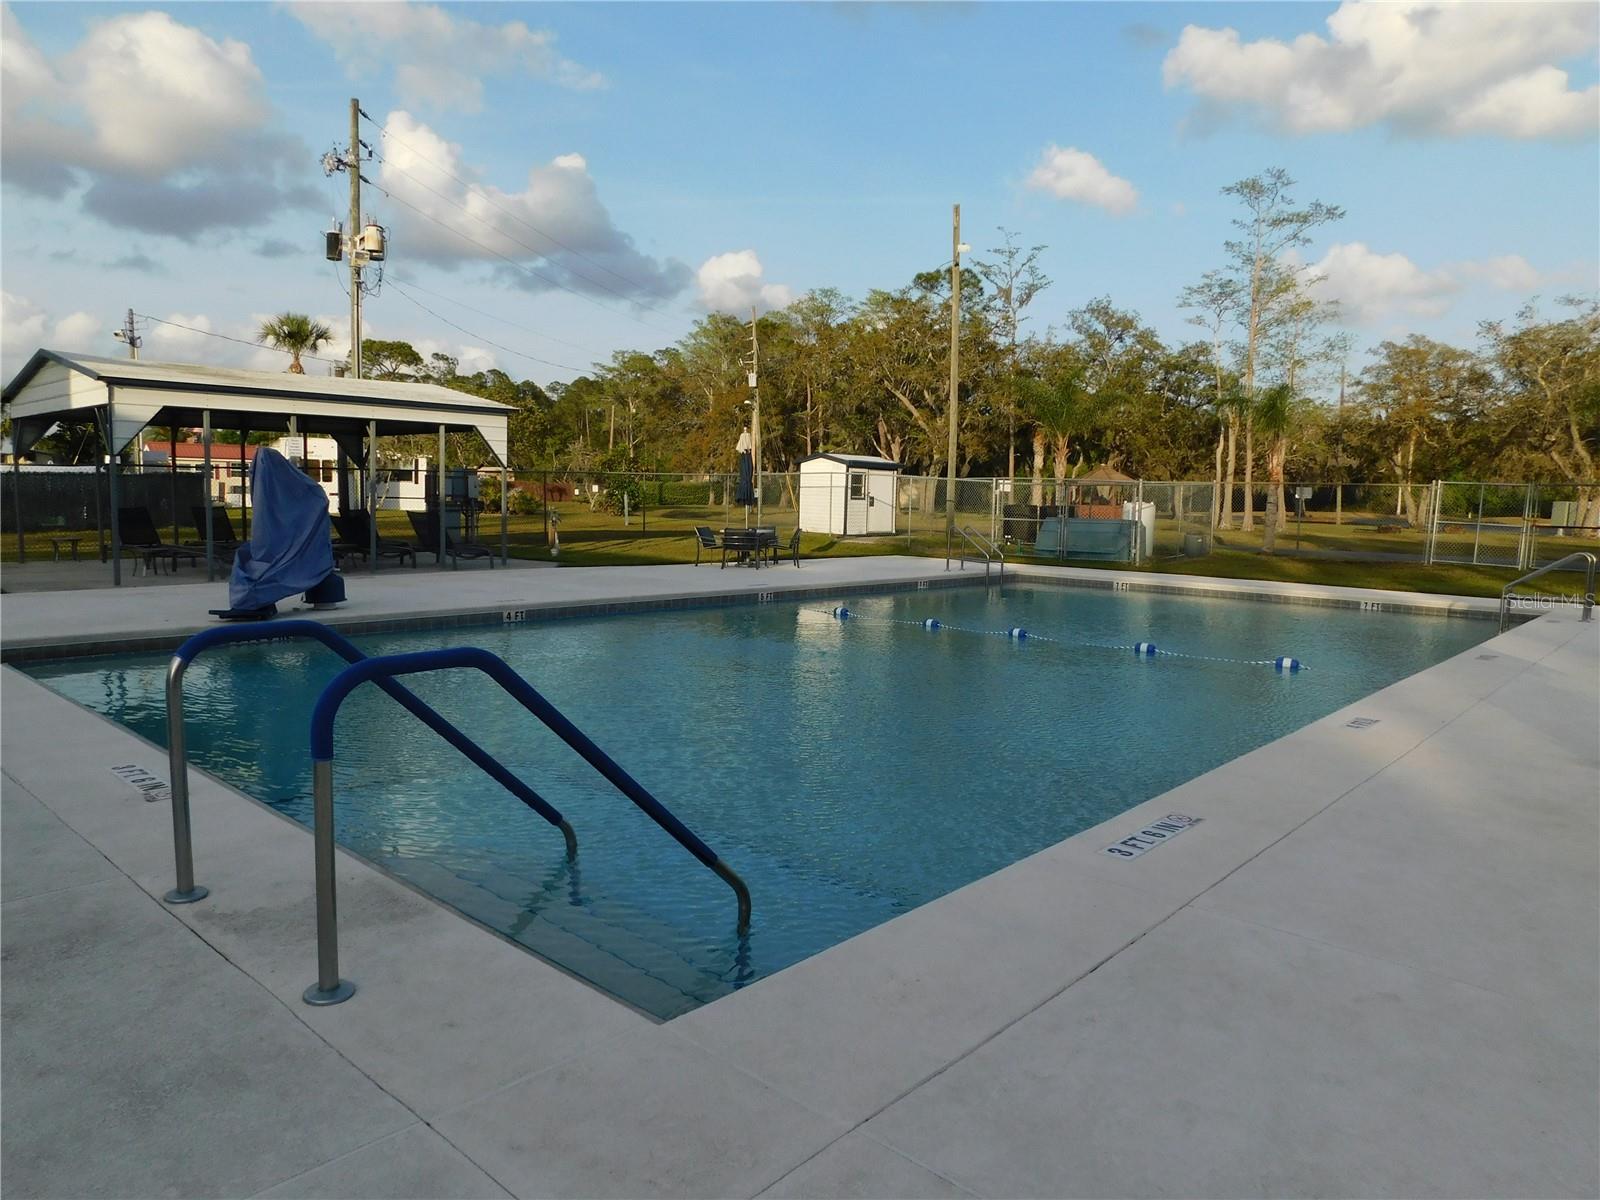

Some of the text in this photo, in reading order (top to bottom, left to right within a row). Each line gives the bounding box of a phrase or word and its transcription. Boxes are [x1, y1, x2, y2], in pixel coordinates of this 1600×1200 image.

[1122, 582, 1129, 592] FT
[766, 592, 773, 600] FT
[1371, 602, 1380, 611] FT
[506, 611, 525, 621] 4 FT
[136, 781, 169, 792] IN
[1107, 821, 1185, 857] 3 FT 6 IN
